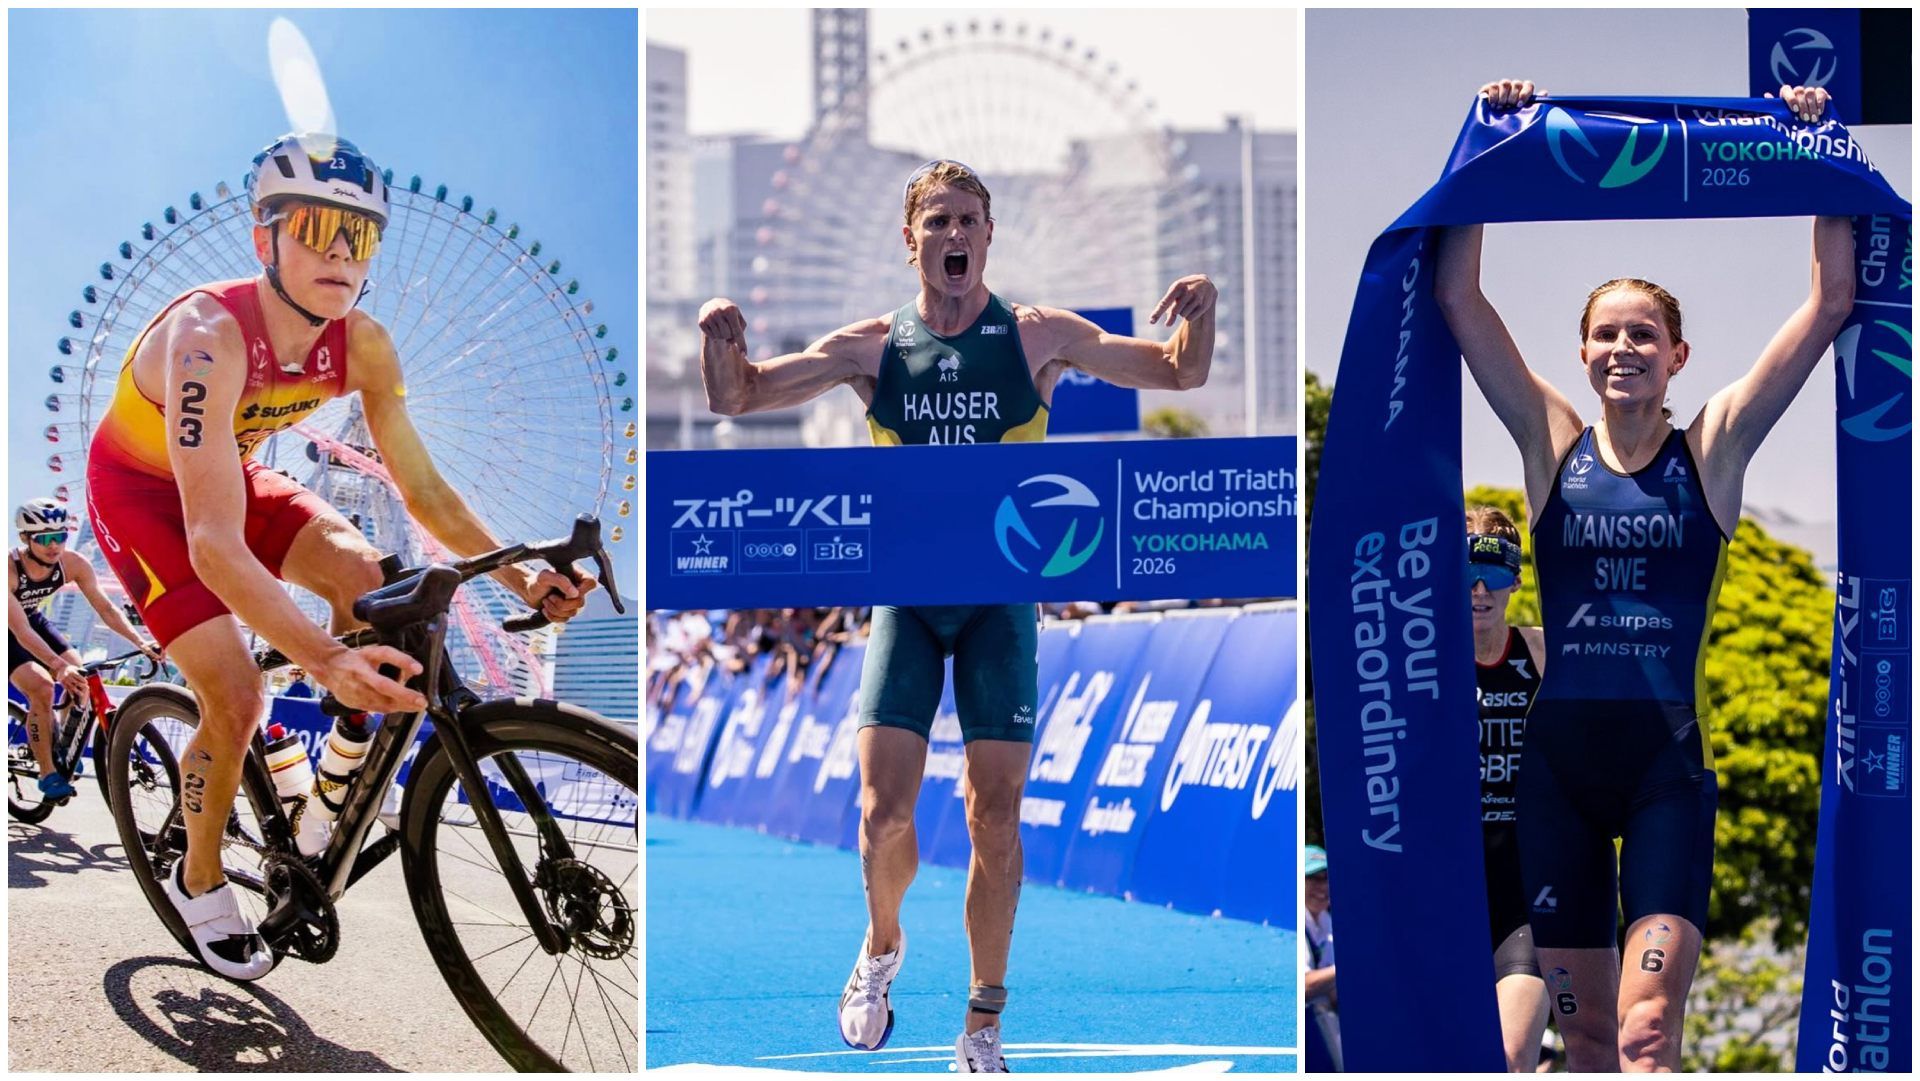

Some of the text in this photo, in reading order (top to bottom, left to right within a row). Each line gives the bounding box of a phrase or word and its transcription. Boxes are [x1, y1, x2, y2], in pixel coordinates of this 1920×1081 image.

[1701, 141, 1818, 162] YOKOHA
[330, 158, 346, 169] 23
[1702, 168, 1750, 186] 2026
[939, 372, 958, 382] AIS
[260, 398, 320, 418] SUZUKI
[904, 391, 1000, 421] HAUSER
[928, 424, 976, 446] AUS
[1134, 469, 1214, 493] World
[671, 489, 872, 529] スポーツくじ
[1563, 514, 1684, 549] MANSSON
[1132, 532, 1269, 553] YOKOHAMA
[676, 556, 729, 570] WINNER
[1132, 557, 1176, 575] 2026
[1594, 556, 1647, 591] SWE
[31, 587, 54, 596] NTT
[1389, 516, 1439, 700] Be your
[1600, 615, 1673, 631] surpas
[1585, 642, 1672, 658] MNSTRY
[1351, 531, 1407, 853] extraordinary
[1482, 692, 1528, 707] asics
[1885, 734, 1901, 790] WINNER
[1640, 948, 1666, 974] 6
[1556, 991, 1578, 1016] 6
